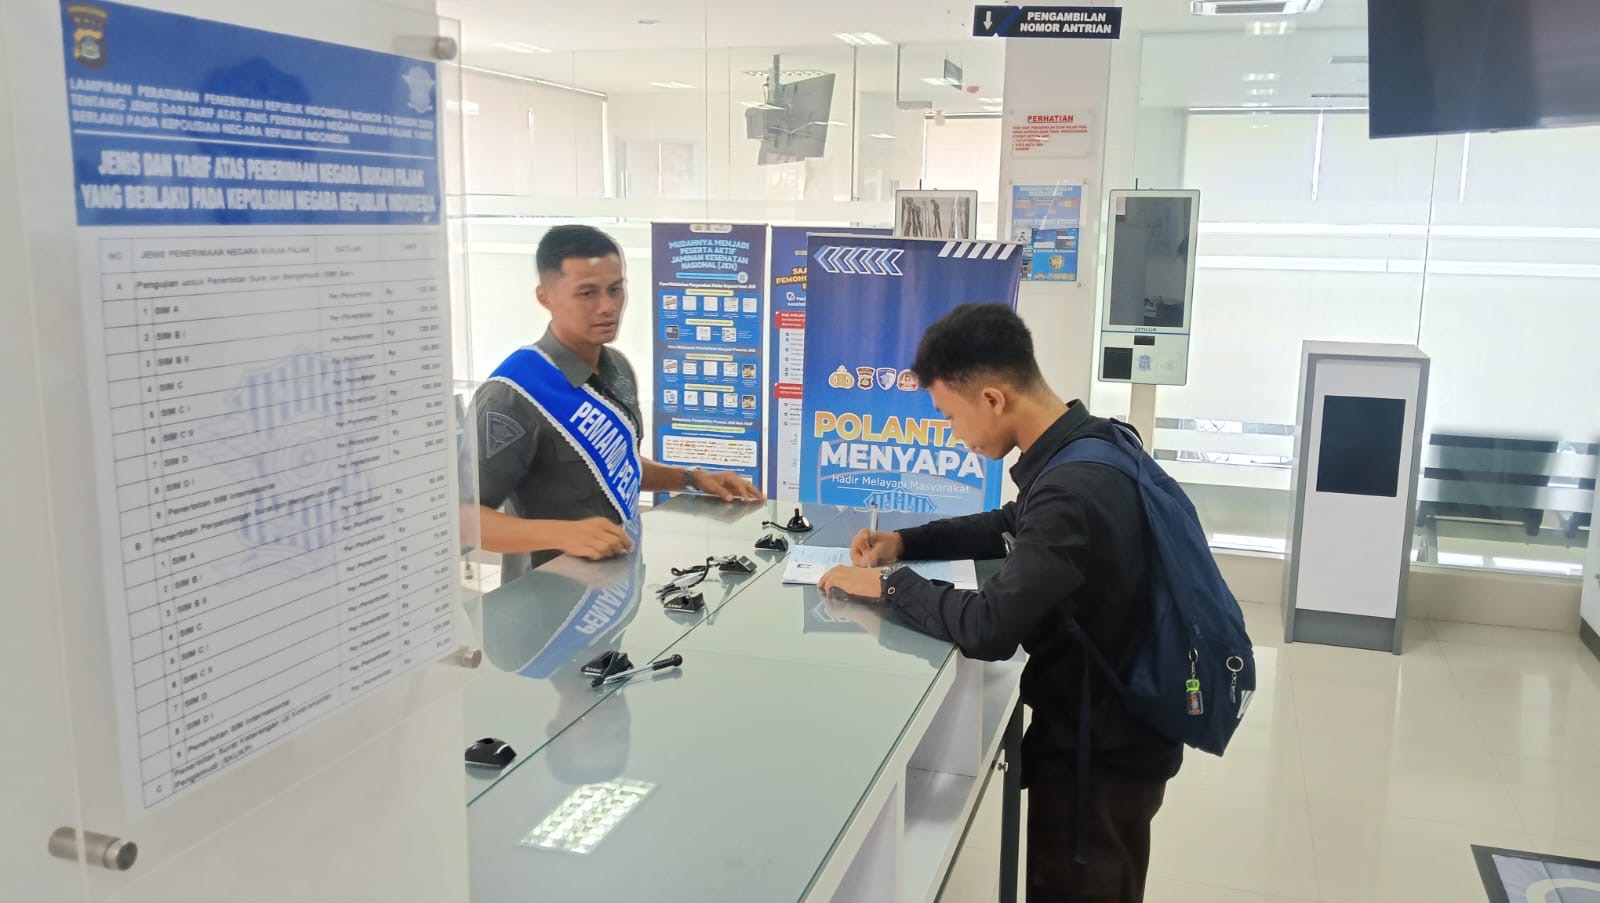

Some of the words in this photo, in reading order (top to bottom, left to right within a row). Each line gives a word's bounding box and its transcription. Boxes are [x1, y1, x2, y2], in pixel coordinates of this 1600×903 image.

[1027, 11, 1106, 22] PENGAMBILAN
[1020, 23, 1060, 33] NOMOR
[1062, 23, 1112, 34] ANTRIAN
[69, 78, 132, 96] LAMPIRAN
[137, 85, 199, 103] PERATURAN
[204, 93, 263, 110] PEMERINTAH
[71, 93, 126, 111] TENTANG
[130, 100, 160, 113] JENIS
[161, 103, 186, 116] DAN
[188, 106, 215, 118] TARIF
[217, 109, 241, 121] ATAS
[72, 110, 125, 126] BERLAKU
[126, 115, 159, 128] PADA
[161, 118, 220, 134] KEPOLISIAN
[222, 123, 264, 137] NEGARA
[1027, 115, 1074, 123] PERHATIAN
[98, 150, 141, 176] JENIS
[143, 152, 173, 177] DAN
[174, 154, 212, 178] TARIF
[214, 156, 245, 180] ATAS
[246, 158, 318, 182] PENERIMAAN
[319, 162, 361, 185] NEGARA
[80, 184, 123, 209] YANG
[124, 185, 190, 210] BERLAKU
[191, 187, 226, 210] PADA
[226, 188, 295, 211] KEPOLISIAN
[295, 190, 339, 211] NEGARA
[668, 239, 713, 249] MUDAHNYA
[714, 239, 750, 250] MENJADI
[680, 247, 713, 255] PESERTA
[713, 247, 737, 255] AKTIF
[671, 254, 704, 263] JAMINAN
[705, 255, 749, 264] KESEHATAN
[681, 262, 717, 270] NASIONAL
[820, 441, 984, 478] MENYAPA
[832, 473, 859, 484] Hadir
[862, 476, 907, 489] Melayani
[910, 479, 970, 494] Masyarakat
